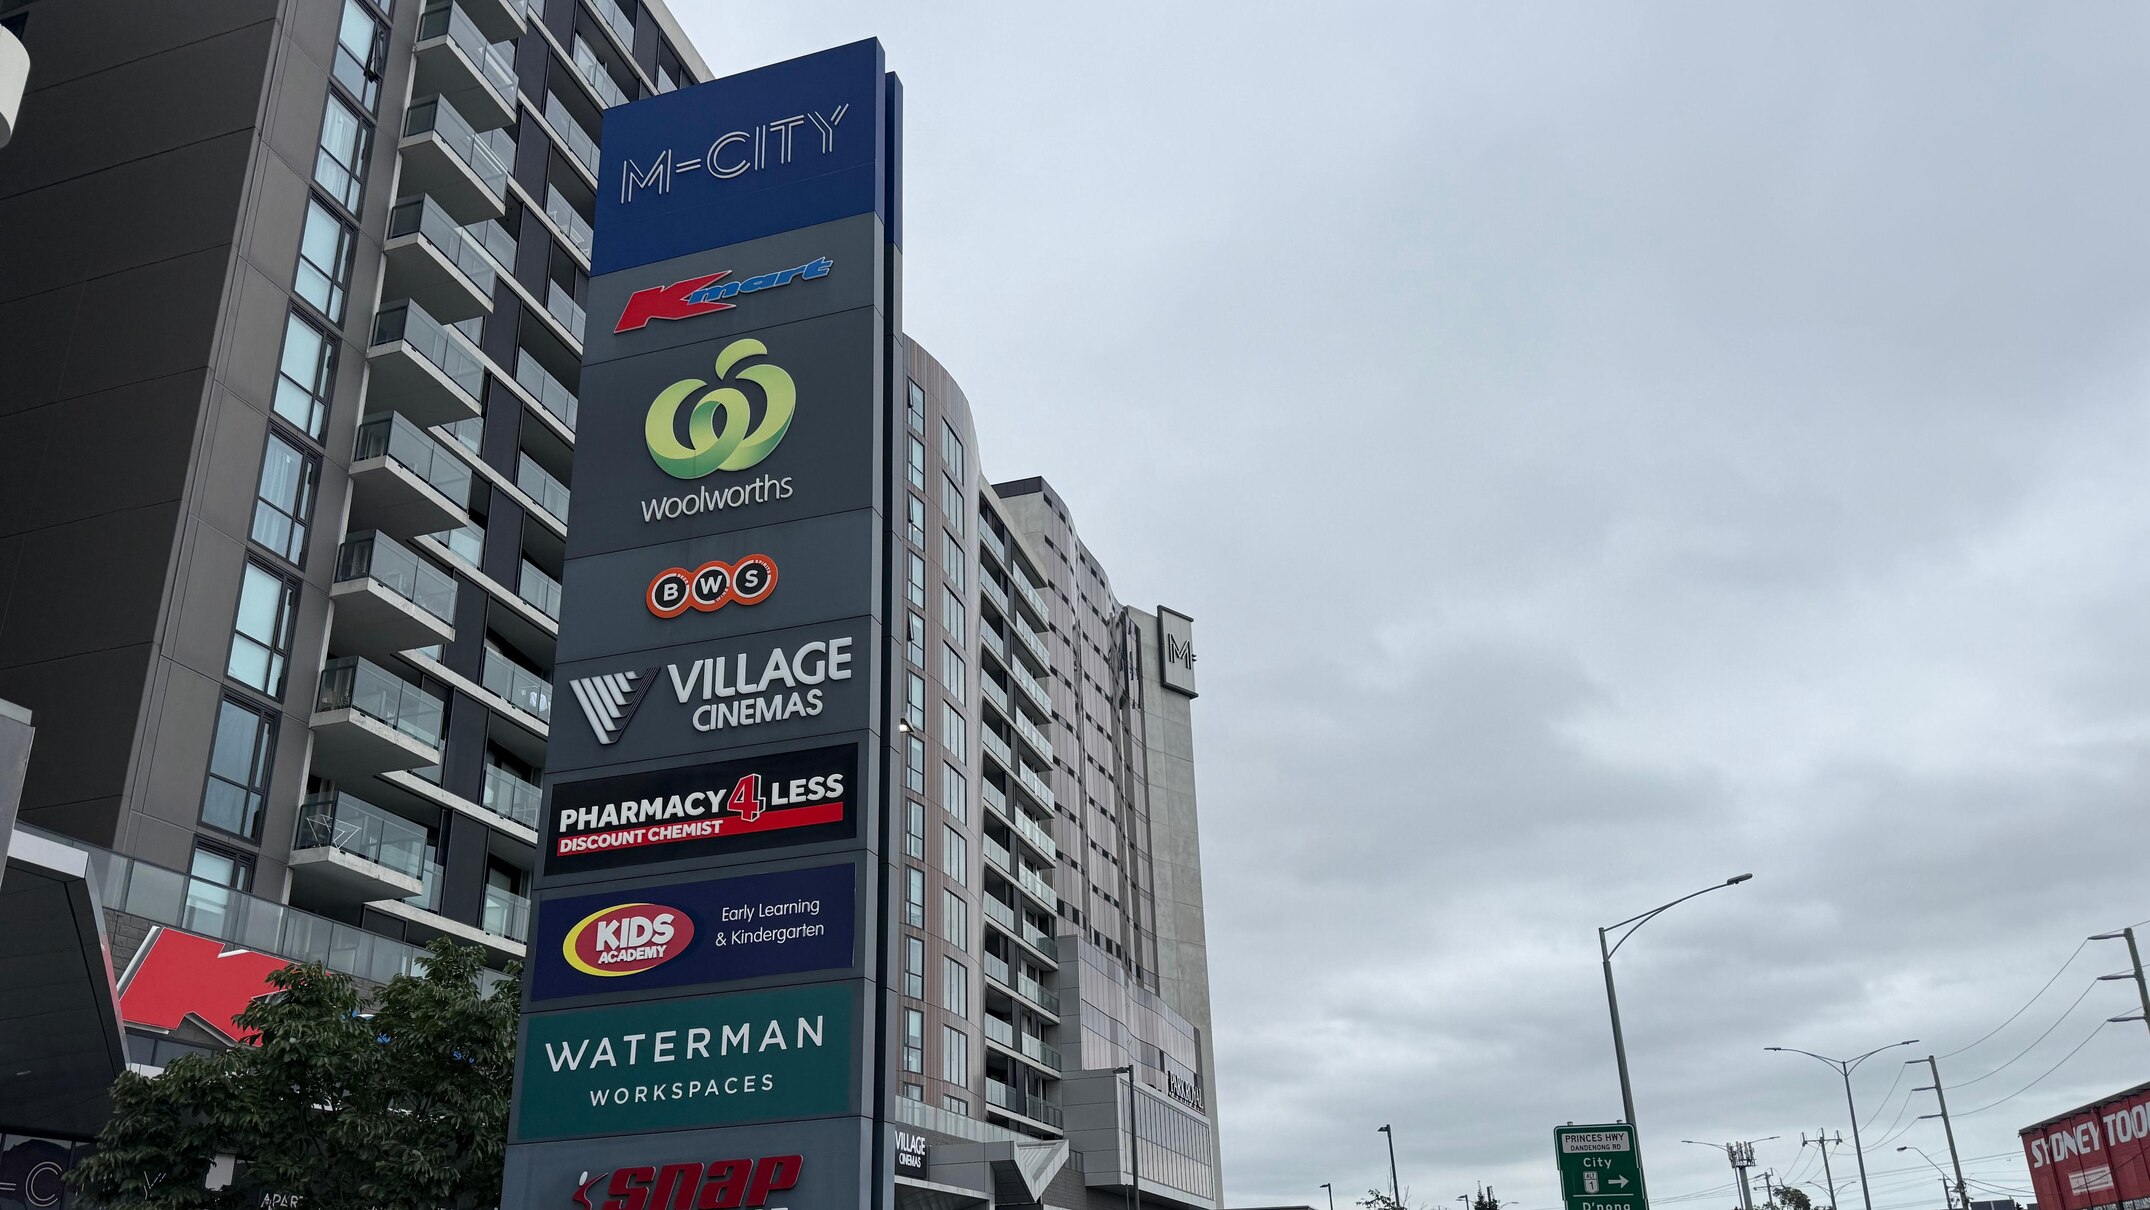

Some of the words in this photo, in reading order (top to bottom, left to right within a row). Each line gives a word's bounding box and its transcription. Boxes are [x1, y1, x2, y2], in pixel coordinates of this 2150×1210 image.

[613, 256, 834, 334] Kmart
[641, 474, 793, 523] Woolworths
[667, 636, 853, 703] VILLAGE
[692, 689, 824, 732] CINEMAS
[559, 788, 727, 833] PHARMACY
[727, 773, 766, 823] 4
[772, 773, 844, 806] LESS
[559, 829, 645, 853] DISCOUNT
[647, 819, 724, 842] CHEMIST
[722, 904, 754, 922] Early
[759, 899, 821, 918] Learning
[595, 913, 675, 951] KIDS
[715, 932, 727, 947] &
[731, 922, 825, 945] Kindergarten
[598, 944, 667, 965] ACADEMY
[545, 1015, 824, 1073] WATERMAN
[590, 1073, 774, 1107] WORKSPACES
[895, 1130, 925, 1155] VILLAGE
[1565, 1134, 1603, 1143] PRINCES
[1605, 1133, 1624, 1141] HWY
[2031, 1121, 2100, 1168] SYDNEY
[899, 1153, 921, 1168] CINEMAS
[1583, 1157, 1612, 1169] City
[602, 1154, 803, 1210] snap
[1589, 1181, 1594, 1190] 1
